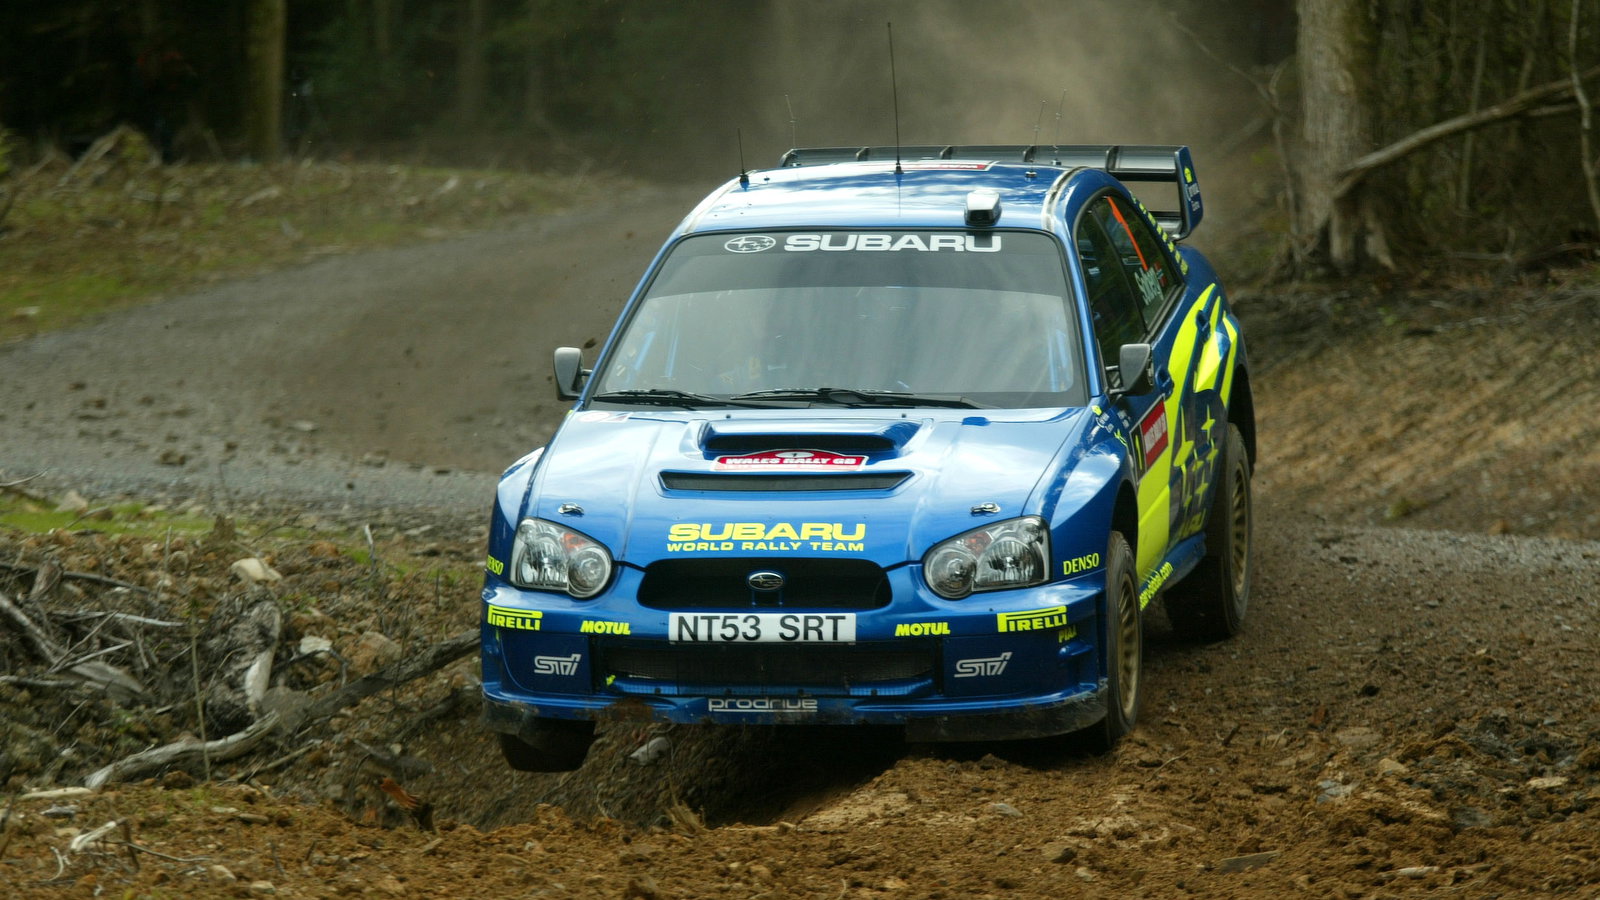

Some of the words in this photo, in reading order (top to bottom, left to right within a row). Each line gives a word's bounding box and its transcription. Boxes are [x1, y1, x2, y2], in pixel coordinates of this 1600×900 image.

[784, 234, 1002, 253] SUBARU
[725, 457, 781, 465] WALES
[783, 457, 830, 465] RALLY
[832, 457, 857, 465] GB
[668, 522, 867, 542] SUBARU
[667, 541, 735, 553] WORLD
[741, 541, 802, 552] RALLY
[810, 541, 865, 552] TEAM
[1062, 552, 1100, 576] DENSO
[486, 604, 544, 631] PIRELLI
[997, 605, 1068, 633] PIRELLI
[579, 620, 632, 636] MOTUL
[677, 615, 762, 642] NT53
[778, 615, 847, 642] SRT
[895, 622, 951, 637] MOTUL
[708, 698, 818, 713] prodrive
